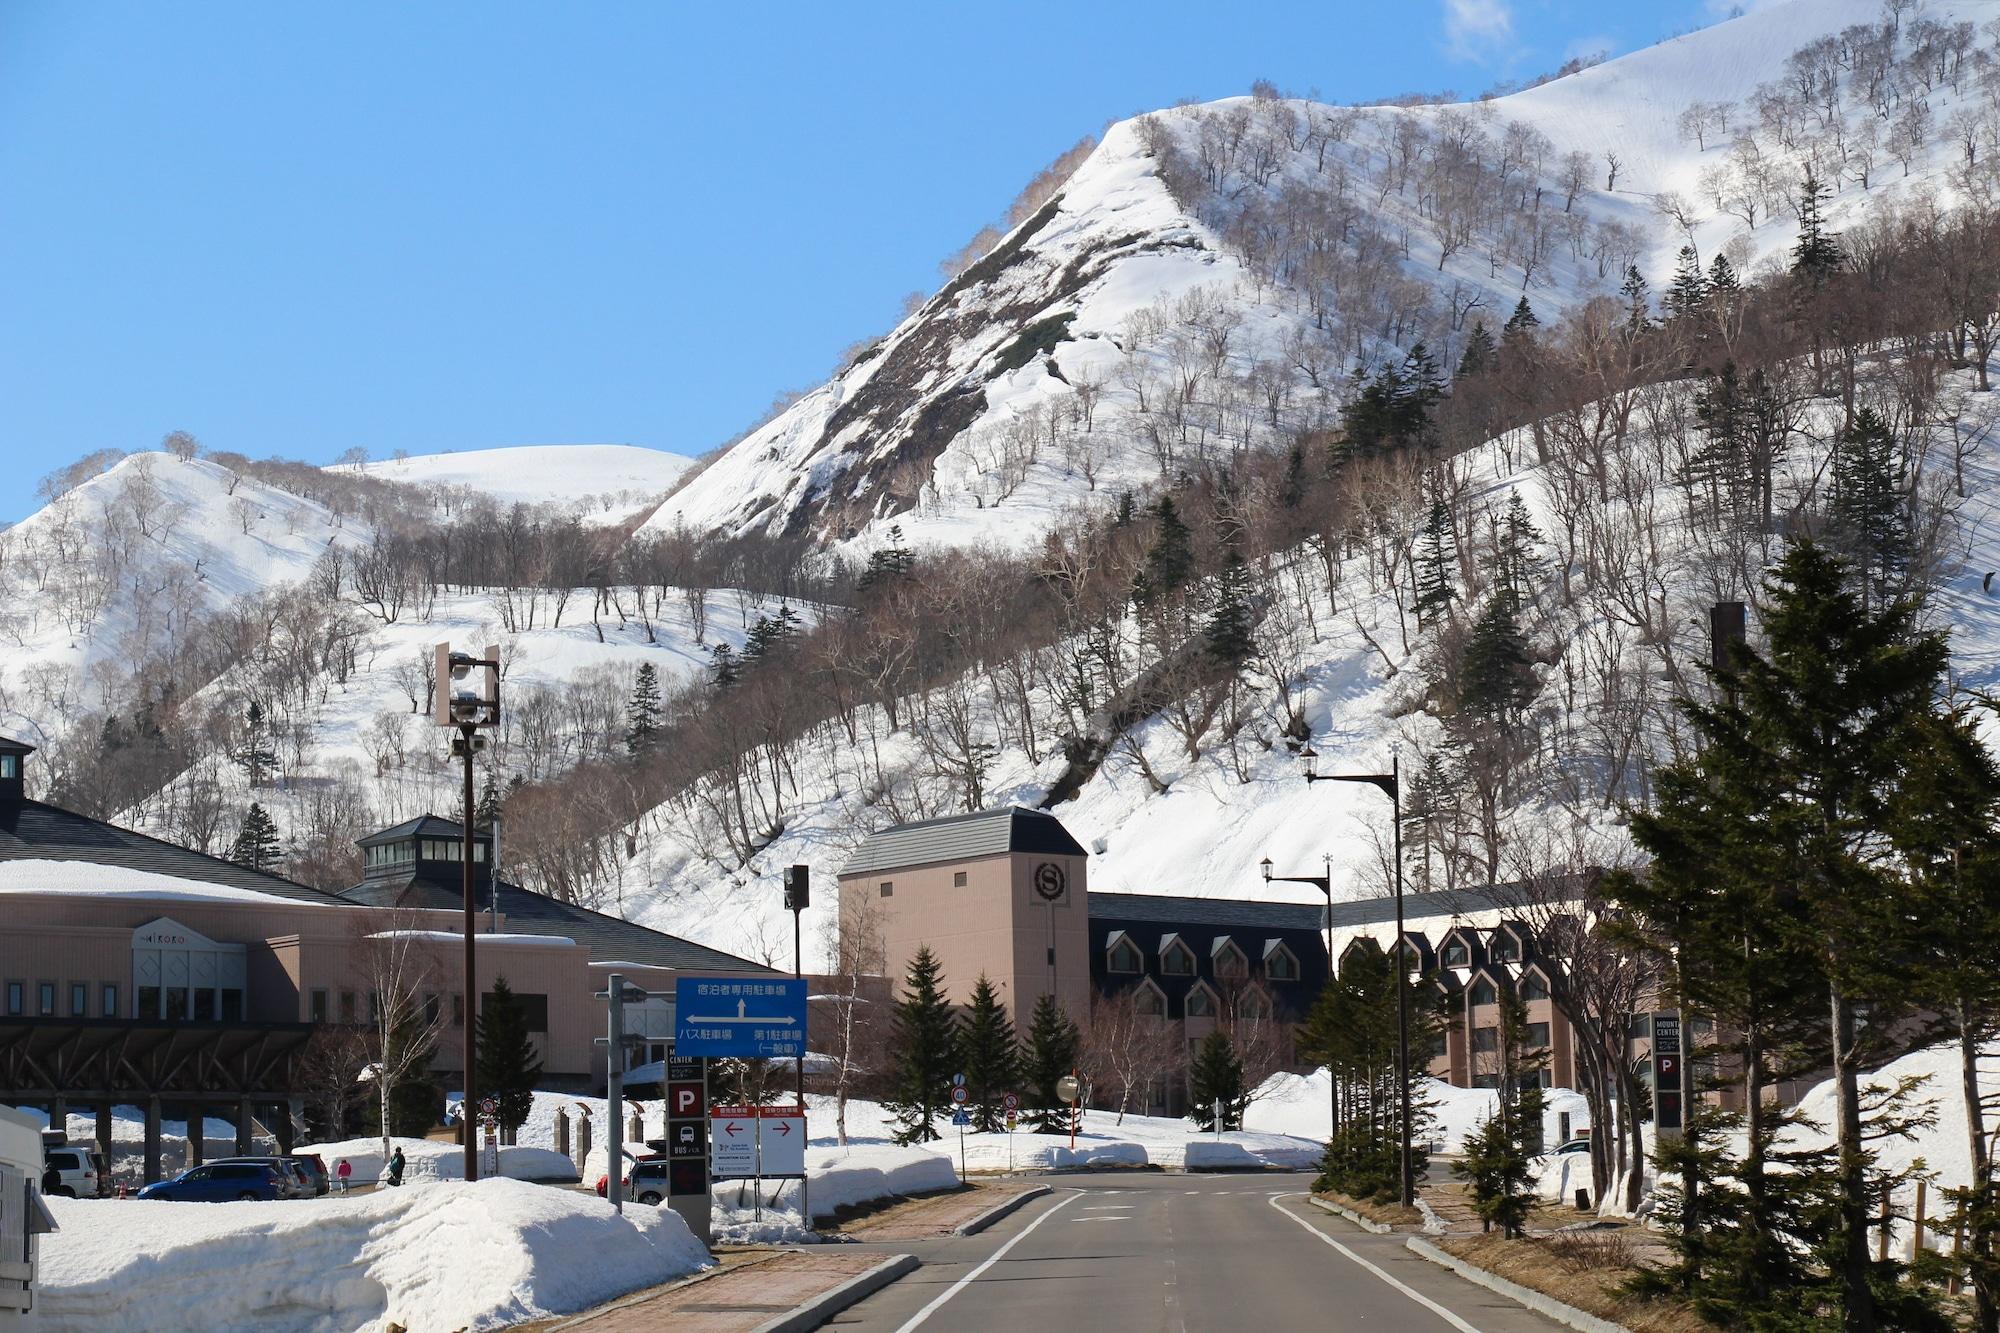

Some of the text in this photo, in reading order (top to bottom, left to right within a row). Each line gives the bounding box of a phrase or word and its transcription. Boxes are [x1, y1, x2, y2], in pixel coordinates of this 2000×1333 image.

[1041, 869, 1058, 892] S
[697, 984, 787, 996] 宿泊者専用駐車場
[679, 1029, 733, 1041] バス駐車場
[753, 1029, 803, 1041] 第1駐車場
[669, 1056, 693, 1064] CENTER
[1662, 1059, 1672, 1072] P
[678, 1090, 696, 1112] P
[955, 1090, 967, 1100] 40
[674, 1146, 687, 1154] BUS
